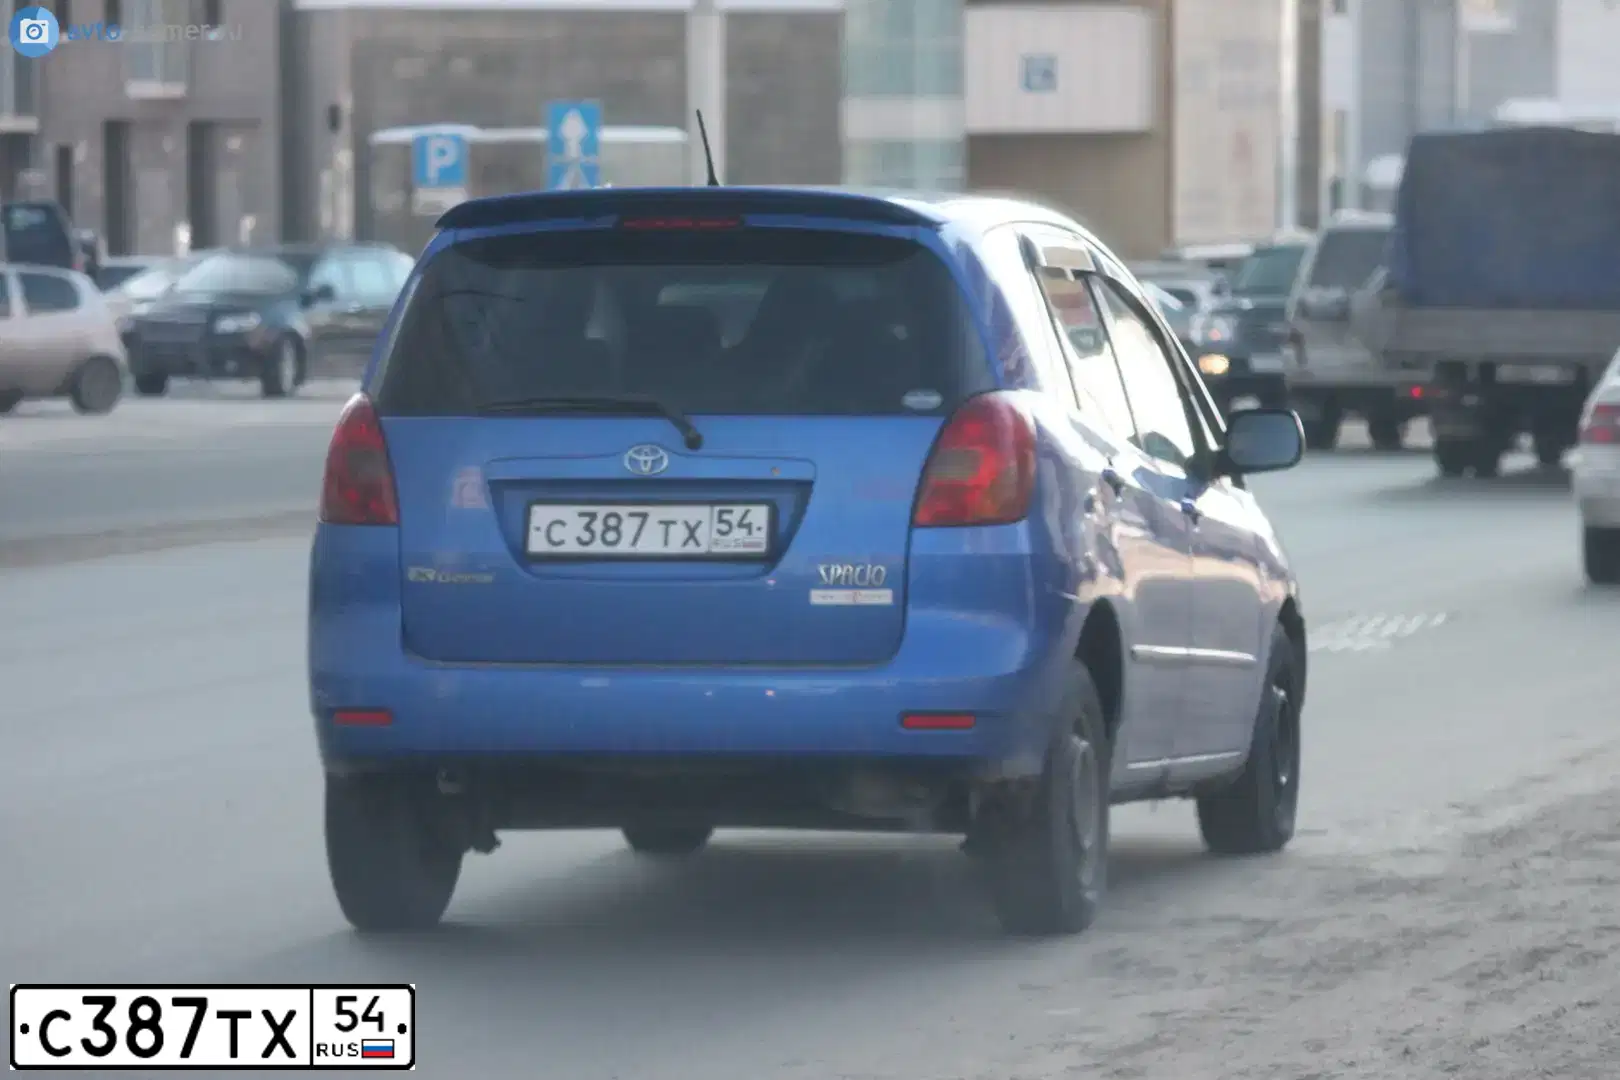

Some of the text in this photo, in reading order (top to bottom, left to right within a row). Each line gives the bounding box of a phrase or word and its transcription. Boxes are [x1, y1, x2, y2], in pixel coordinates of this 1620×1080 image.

[427, 137, 458, 185] P
[716, 509, 753, 536] 54
[817, 563, 887, 587] SPACIO
